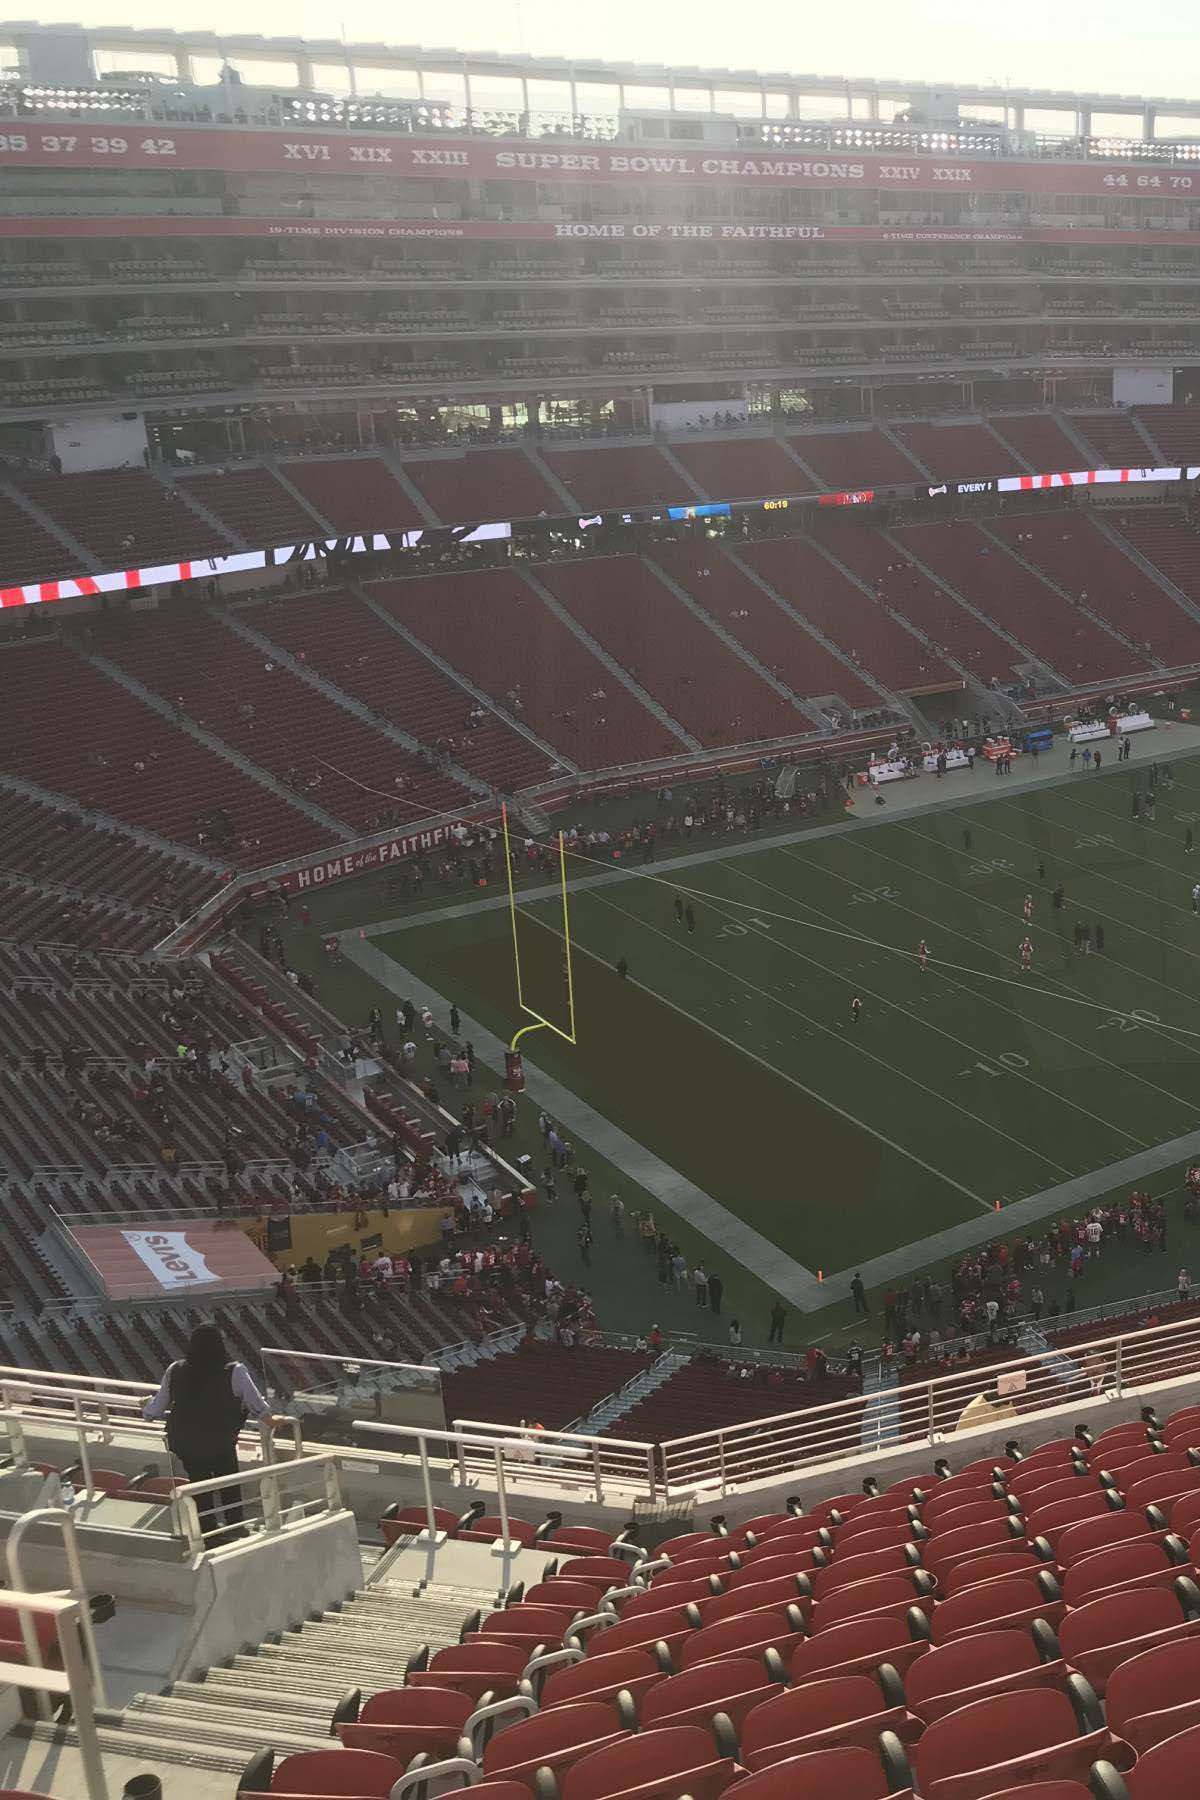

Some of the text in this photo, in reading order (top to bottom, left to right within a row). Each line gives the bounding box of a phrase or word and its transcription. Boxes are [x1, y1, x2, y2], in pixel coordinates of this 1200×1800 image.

[41, 136, 77, 152] 37
[90, 137, 128, 153] 39
[140, 139, 177, 155] 42
[283, 144, 972, 181] XVI XIX XXIII SUPER BOWL CHAMPIONS XXIV XXIX
[555, 224, 824, 238] HOME OF THE FAITHFUL
[958, 482, 986, 494] EVERY
[298, 857, 354, 887] HOME
[355, 858, 365, 869] of
[364, 853, 378, 865] the
